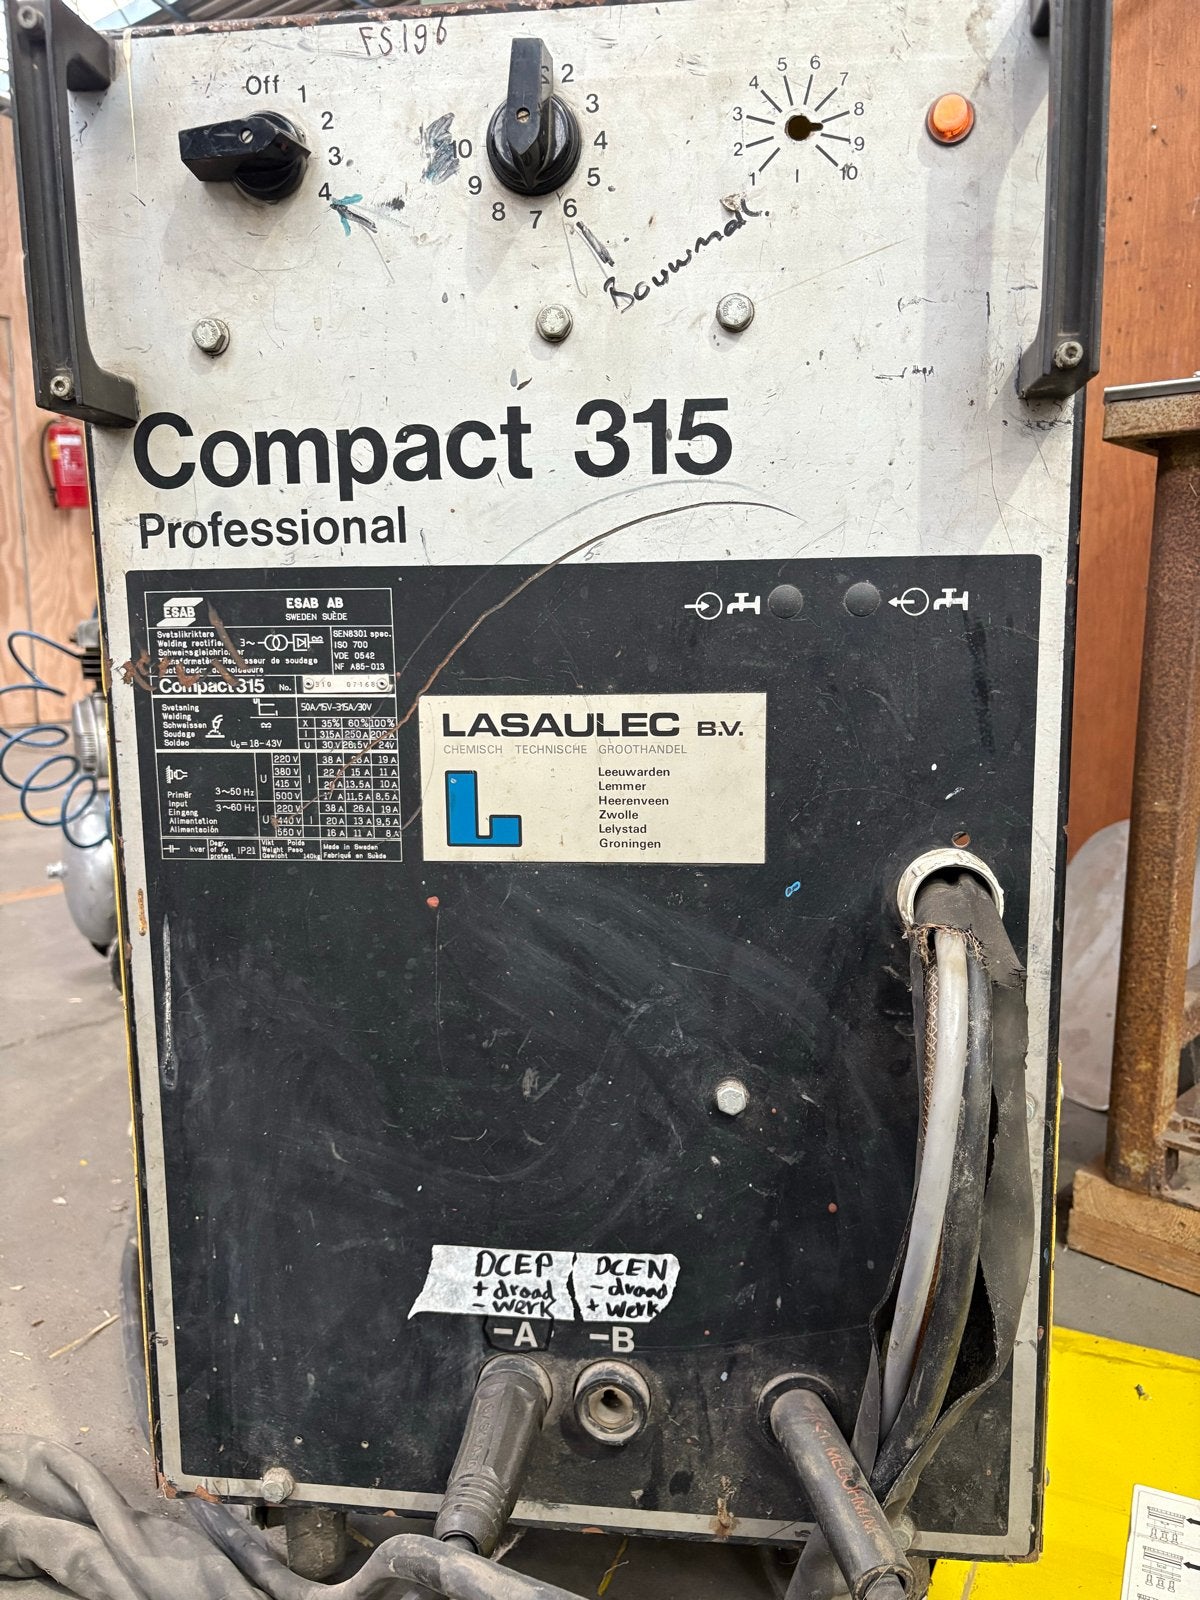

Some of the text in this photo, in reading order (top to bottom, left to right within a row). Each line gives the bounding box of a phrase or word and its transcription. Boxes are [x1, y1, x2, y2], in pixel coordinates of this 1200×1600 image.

[359, 16, 447, 56] FS196
[777, 57, 788, 72] 5
[810, 55, 820, 70] 6
[561, 63, 574, 83] 2
[840, 72, 849, 86] 7
[245, 75, 280, 95] Off
[749, 75, 759, 90] 4
[298, 84, 306, 103] 1
[585, 93, 600, 114] 3
[854, 101, 864, 116] 8
[321, 111, 334, 130] 2
[732, 106, 743, 121] 3
[594, 130, 608, 150] 4
[854, 136, 865, 151] 9
[451, 138, 473, 158] 10
[733, 142, 744, 157] 2
[328, 146, 342, 166] 3
[586, 167, 600, 187] 5
[748, 172, 756, 186] 1
[840, 165, 858, 181] 10
[318, 182, 332, 201] 4
[468, 175, 482, 195] 9
[491, 201, 506, 222] 8
[563, 198, 578, 218] 6
[529, 210, 543, 229] 7
[133, 406, 533, 501] Compact
[574, 397, 733, 479] 315
[139, 506, 408, 549] Professional
[285, 596, 344, 609] ESAB AB
[163, 606, 196, 618] ESAB
[285, 610, 348, 621] SWEDEN SUÈDE
[334, 652, 350, 660] VDE
[334, 662, 345, 670] NF
[279, 684, 292, 692] No.
[162, 713, 192, 722] Welding
[442, 712, 744, 738] LASAULEC B.V.
[443, 744, 688, 754] CHEMISCH TECHNISCHE GROOTHANDEL
[598, 767, 671, 777] Leeuwarden
[244, 788, 255, 796] Hz
[598, 782, 647, 792] Lemmer
[244, 804, 256, 812] Hz
[598, 796, 670, 806] Heerenveen
[598, 810, 639, 820] Zwolle
[598, 824, 648, 836] Lelystad
[238, 846, 256, 854] IP21
[599, 838, 662, 850] Groningen
[474, 1250, 554, 1278] DCEP
[594, 1256, 668, 1280] DCEN
